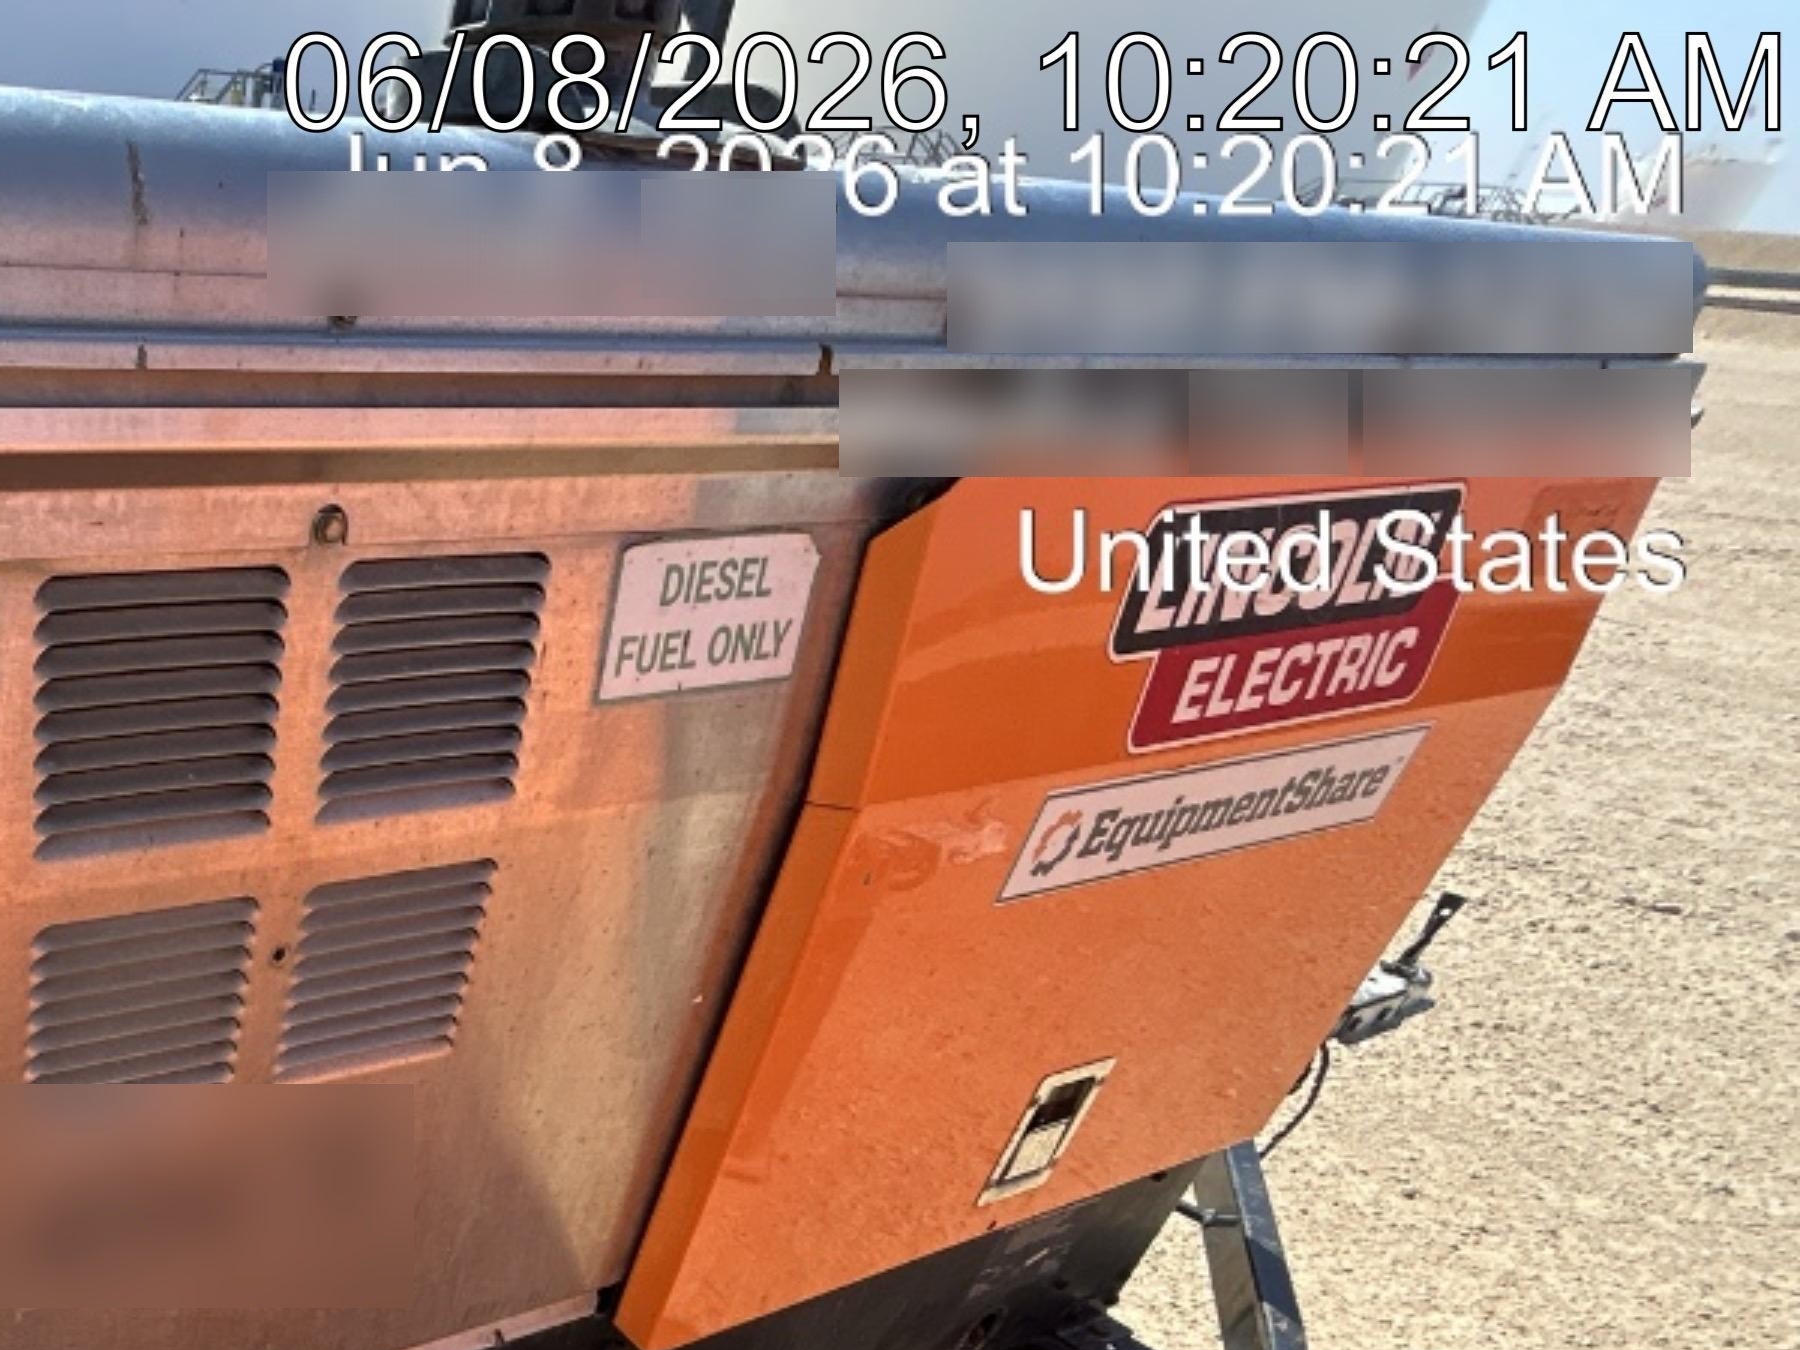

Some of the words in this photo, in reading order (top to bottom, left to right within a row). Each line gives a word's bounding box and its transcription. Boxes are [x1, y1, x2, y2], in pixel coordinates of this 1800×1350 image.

[659, 557, 772, 607] DIESEL
[614, 629, 696, 678] FUEL
[707, 618, 793, 667] ONLY
[1171, 626, 1420, 724] ELECTRIC
[1077, 764, 1391, 862] EquipmentShare
